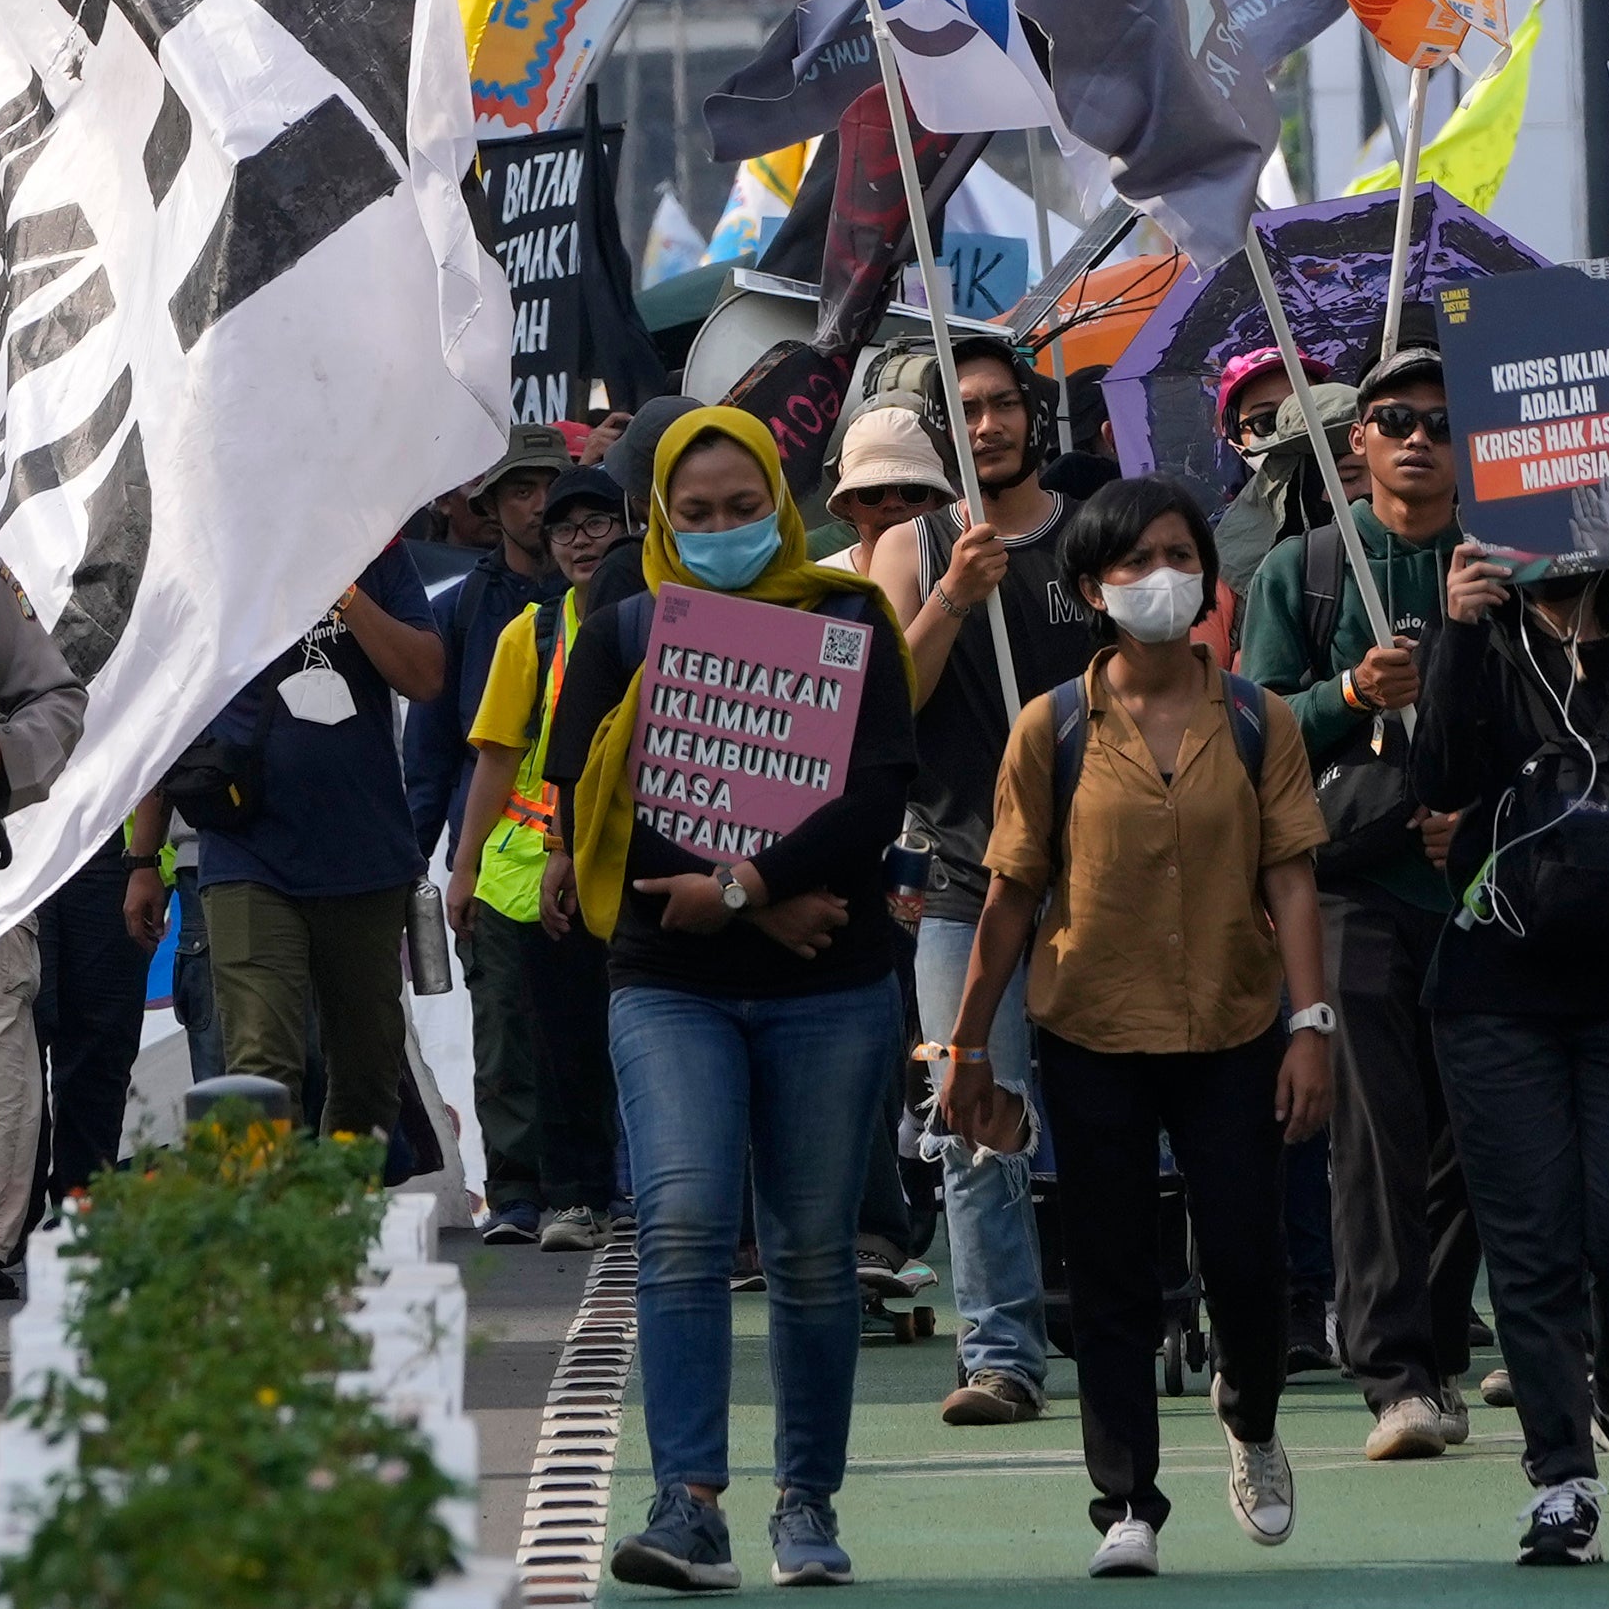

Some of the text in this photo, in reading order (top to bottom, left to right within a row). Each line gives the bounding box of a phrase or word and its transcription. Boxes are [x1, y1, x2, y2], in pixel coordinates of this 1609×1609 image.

[1490, 355, 1558, 394] KRISIS
[1519, 385, 1598, 423] ADALAH
[1474, 427, 1543, 464] KRISIS
[1544, 422, 1588, 454] HAK
[657, 643, 843, 713] KEBIJAKAN
[651, 683, 793, 742] IKLIMMU
[644, 723, 832, 791] MEMBUNUH
[637, 761, 733, 813] MASA
